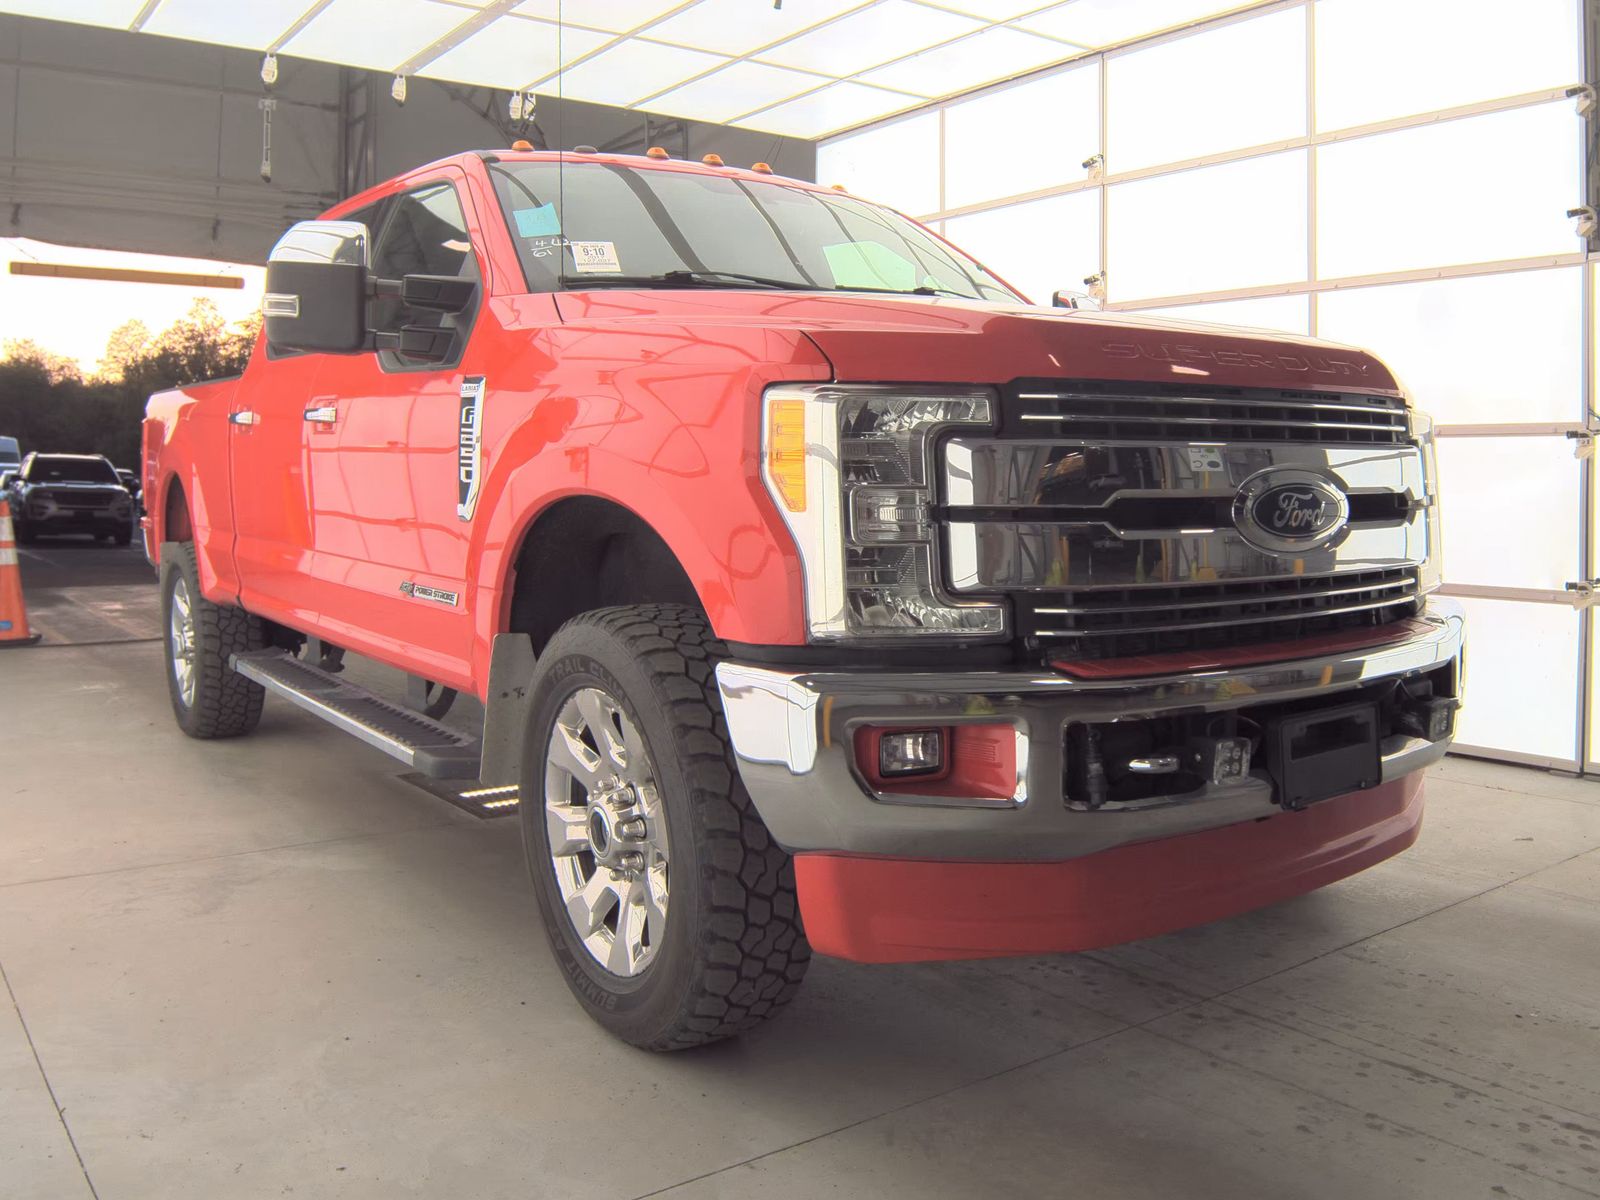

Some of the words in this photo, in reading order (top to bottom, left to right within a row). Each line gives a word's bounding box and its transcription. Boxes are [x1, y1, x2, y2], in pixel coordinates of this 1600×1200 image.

[582, 247, 605, 256] 9:10
[1101, 343, 1275, 369] SUPER
[1276, 353, 1370, 377] DUTY
[1273, 491, 1325, 528] Ford
[433, 590, 455, 602] STROKE
[547, 658, 585, 683] TRAIL
[565, 960, 617, 1010] SUMMIT
